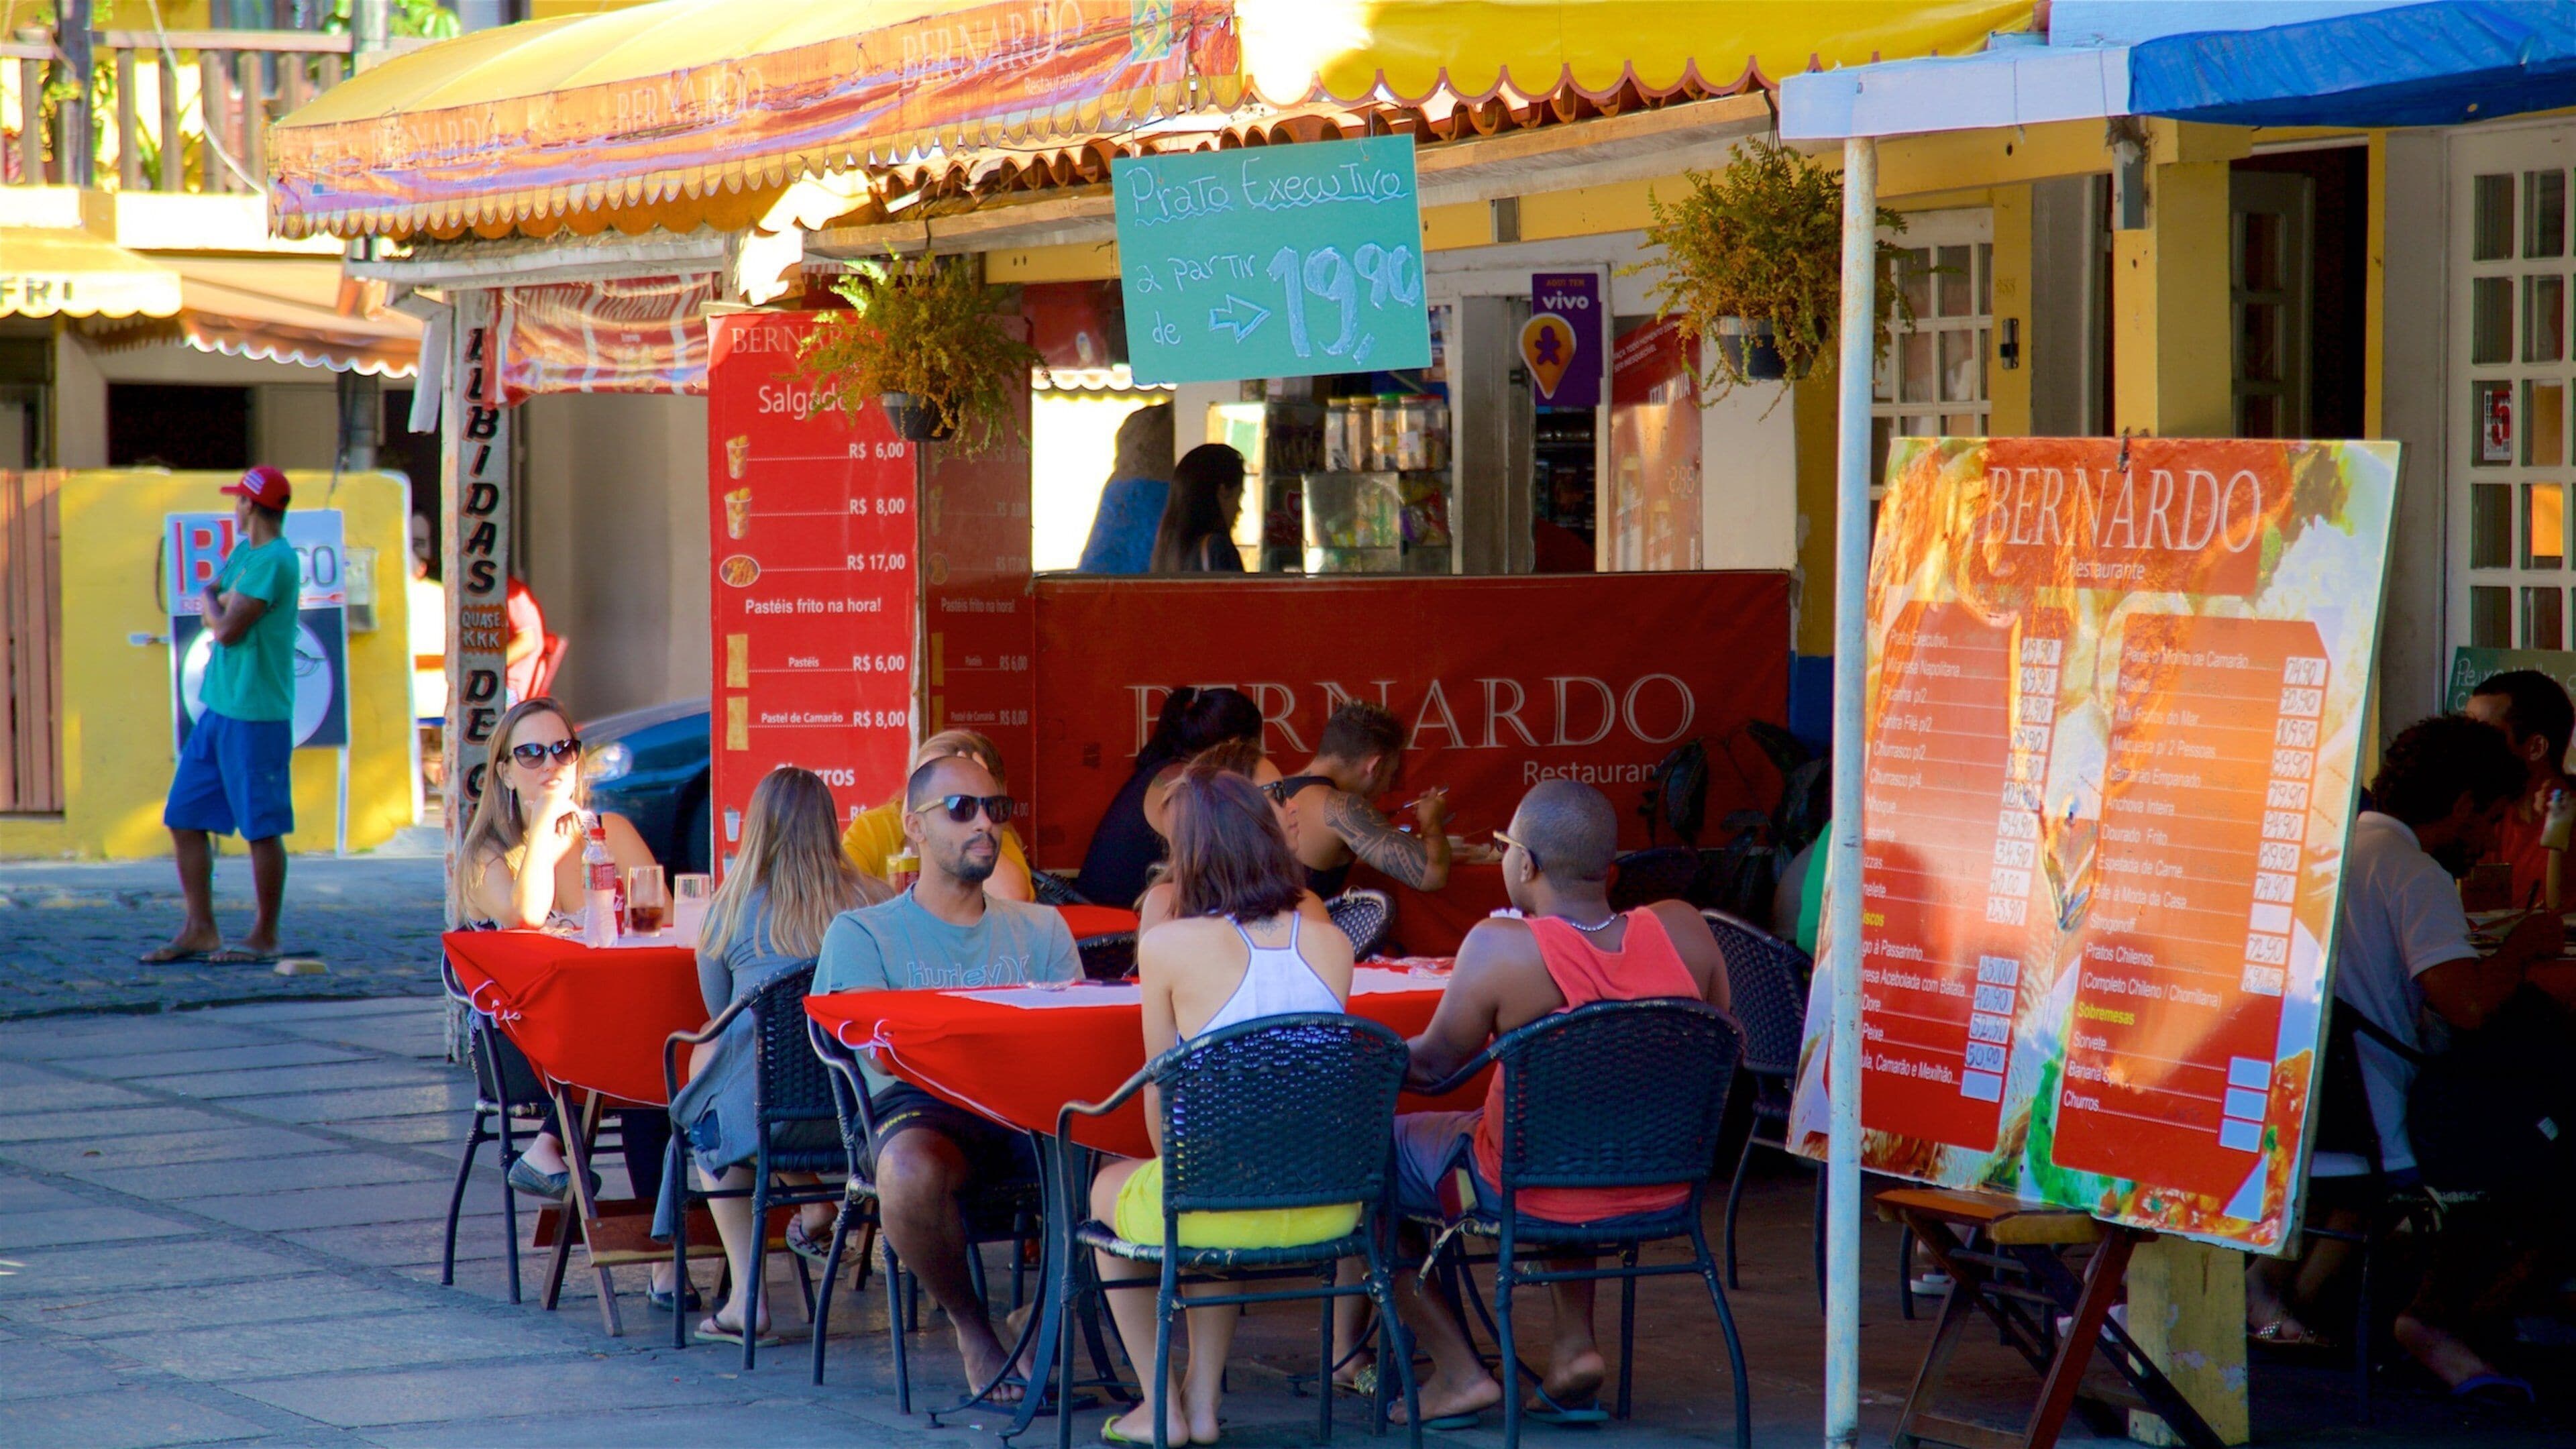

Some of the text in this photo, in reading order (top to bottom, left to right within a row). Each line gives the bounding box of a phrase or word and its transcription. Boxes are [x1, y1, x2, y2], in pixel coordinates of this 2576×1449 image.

[901, 1, 1085, 89] BERNARDO
[1024, 69, 1082, 95] Restaurante
[616, 67, 765, 134] BERNARDO
[1542, 290, 1589, 310] vivo
[1152, 311, 1181, 346] de
[730, 326, 847, 354] BERNAR
[848, 441, 905, 460] R$ 6,00
[849, 497, 905, 517] R$ 8,00
[1981, 467, 2261, 553] BERNARDO
[847, 553, 906, 572] R$ 17,00
[2068, 557, 2146, 580] Restaurante
[745, 596, 881, 614] Pastéis frito na hora!
[462, 611, 500, 629] QUASE
[462, 629, 500, 648] KKK
[788, 654, 905, 674] Pastéis R$ 6,00
[2192, 651, 2205, 666] de
[2206, 651, 2249, 669] Camarão
[761, 710, 905, 729] Pastel de Camarão R$ 8,00
[1123, 673, 1696, 757] BRARDO
[2166, 710, 2180, 725] do
[2180, 710, 2200, 727] Mar
[1873, 740, 1911, 759] Churrasco
[2178, 740, 2216, 759] Pessoas
[774, 763, 855, 787] rros
[1523, 759, 1664, 786] Restauran
[1869, 767, 1908, 787] Churrasco
[2152, 768, 2201, 789] Empanado
[2146, 798, 2176, 816] Inteira
[1865, 826, 1896, 843] asanha
[2101, 823, 2168, 847] Dourado Frito
[1864, 854, 1883, 870] izzas
[2141, 859, 2153, 875] de
[2155, 859, 2184, 879] Carne
[2121, 885, 2147, 904] Moda
[2148, 891, 2161, 906] da
[2163, 892, 2188, 910] Casa
[1863, 909, 1886, 926] iscos
[1881, 939, 1923, 961] Passarinho
[2085, 943, 2154, 967] Pratos Chilenos
[1880, 968, 1921, 990] Acebolada
[1921, 978, 1939, 993] com
[1939, 977, 1966, 997] Batata
[2080, 972, 2127, 996] (Completo
[2128, 977, 2162, 1000] Chileno
[2078, 1001, 2135, 1026] Sobremesas
[1862, 1022, 1884, 1042] Peixe
[2073, 1030, 2107, 1053] Sorvete
[1861, 1049, 1953, 1084] ula, Camarão e Mexilhão
[2068, 1061, 2102, 1082] Banana
[2063, 1089, 2100, 1113] Churros
